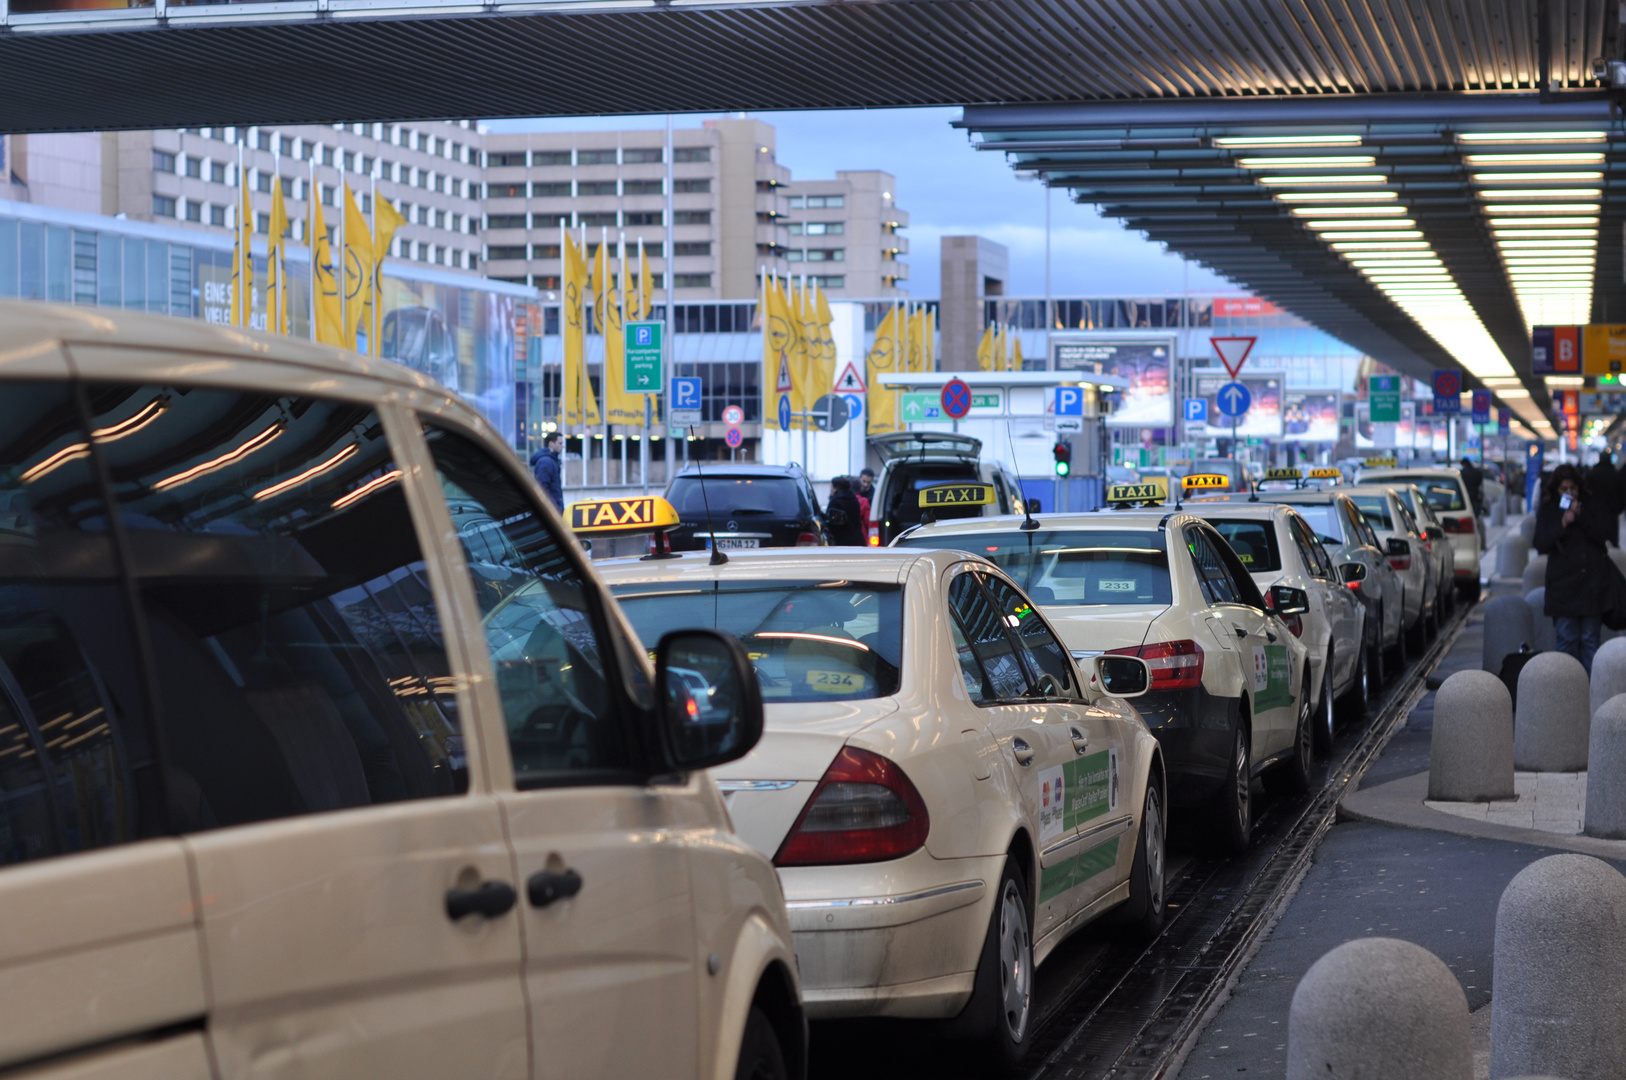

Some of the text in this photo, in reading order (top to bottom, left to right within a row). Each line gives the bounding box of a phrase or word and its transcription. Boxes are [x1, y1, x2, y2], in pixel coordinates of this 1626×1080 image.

[1559, 339, 1573, 362] B
[678, 381, 694, 405] P
[1061, 391, 1076, 412] P
[727, 411, 739, 421] 30
[1189, 402, 1202, 418] P
[1269, 469, 1300, 477] TAXI
[1313, 469, 1338, 477] TAXI
[1190, 477, 1219, 486] TAXI
[934, 488, 977, 502] TAXI
[1116, 485, 1154, 497] TAXI
[575, 500, 652, 526] TAXI
[732, 540, 743, 549] NA
[745, 540, 755, 549] 12
[1104, 582, 1129, 590] 233
[816, 673, 853, 686] 234
